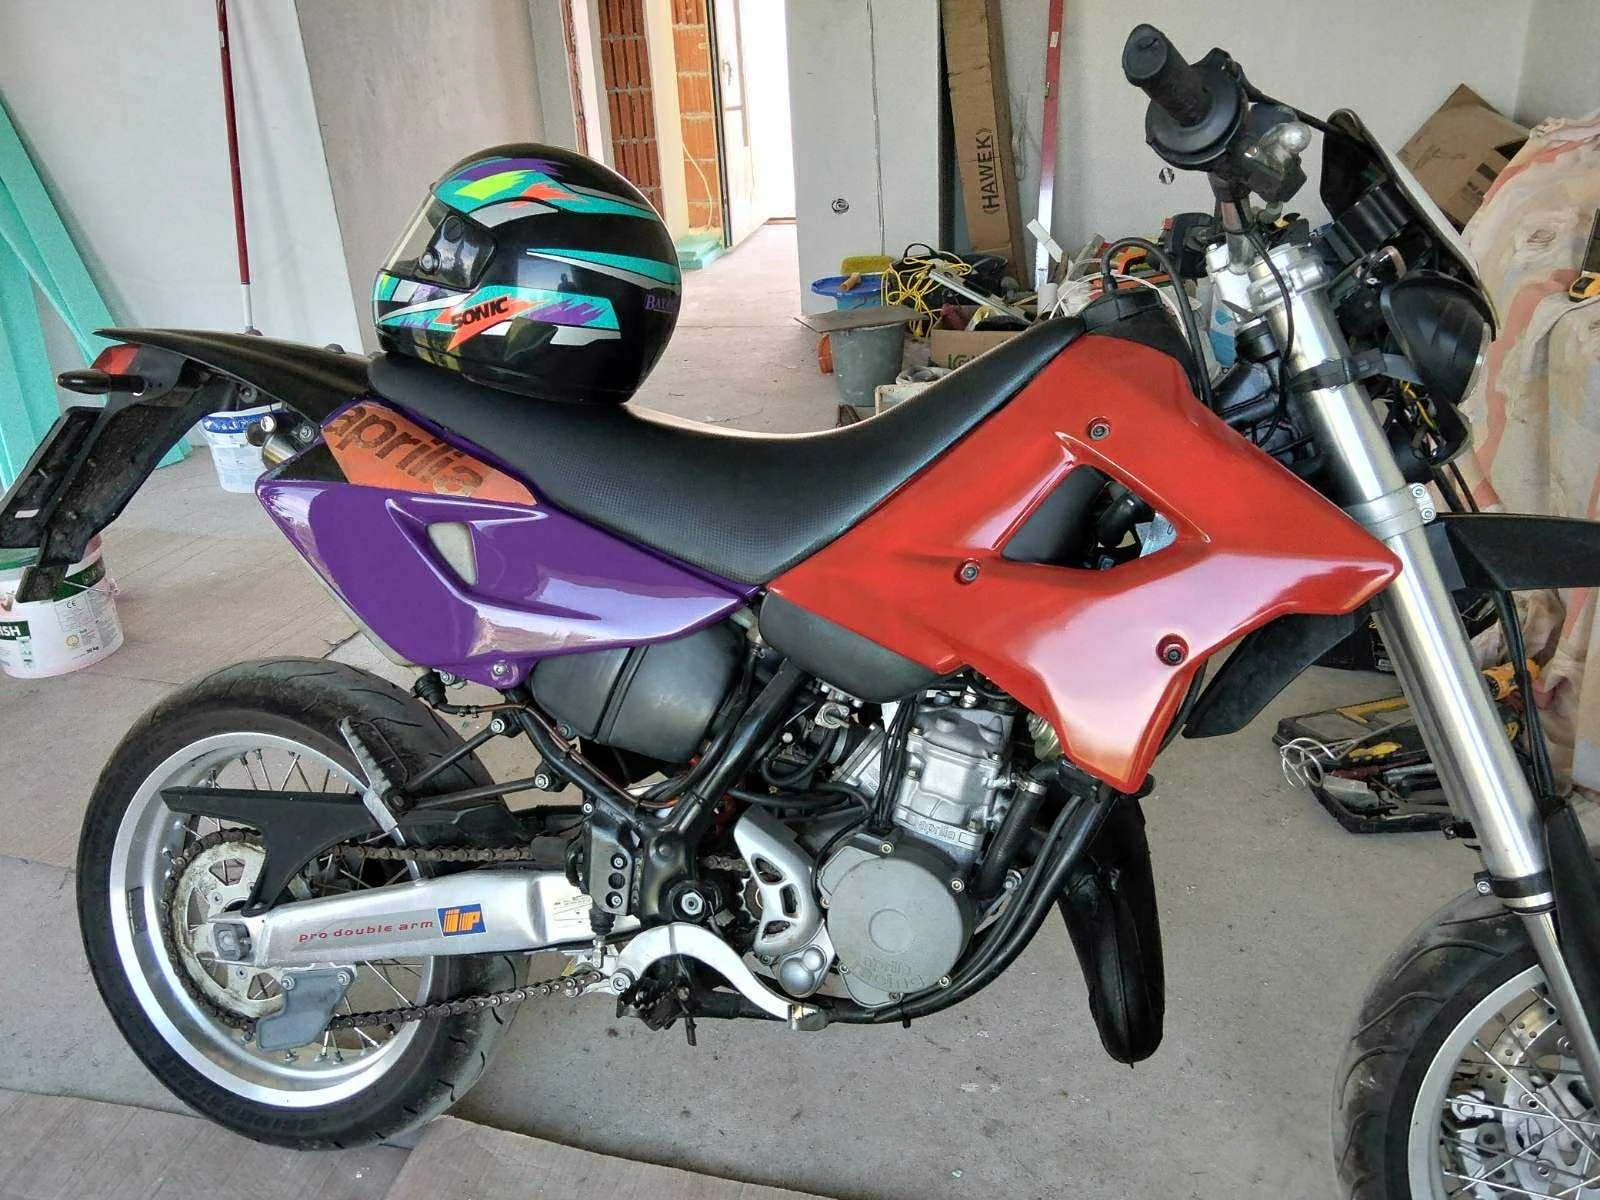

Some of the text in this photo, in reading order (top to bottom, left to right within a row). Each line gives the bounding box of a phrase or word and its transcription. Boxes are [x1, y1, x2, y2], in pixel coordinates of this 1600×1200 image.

[451, 296, 509, 326] SONIC
[323, 405, 483, 498] aprilia
[298, 920, 433, 943] pro double arm
